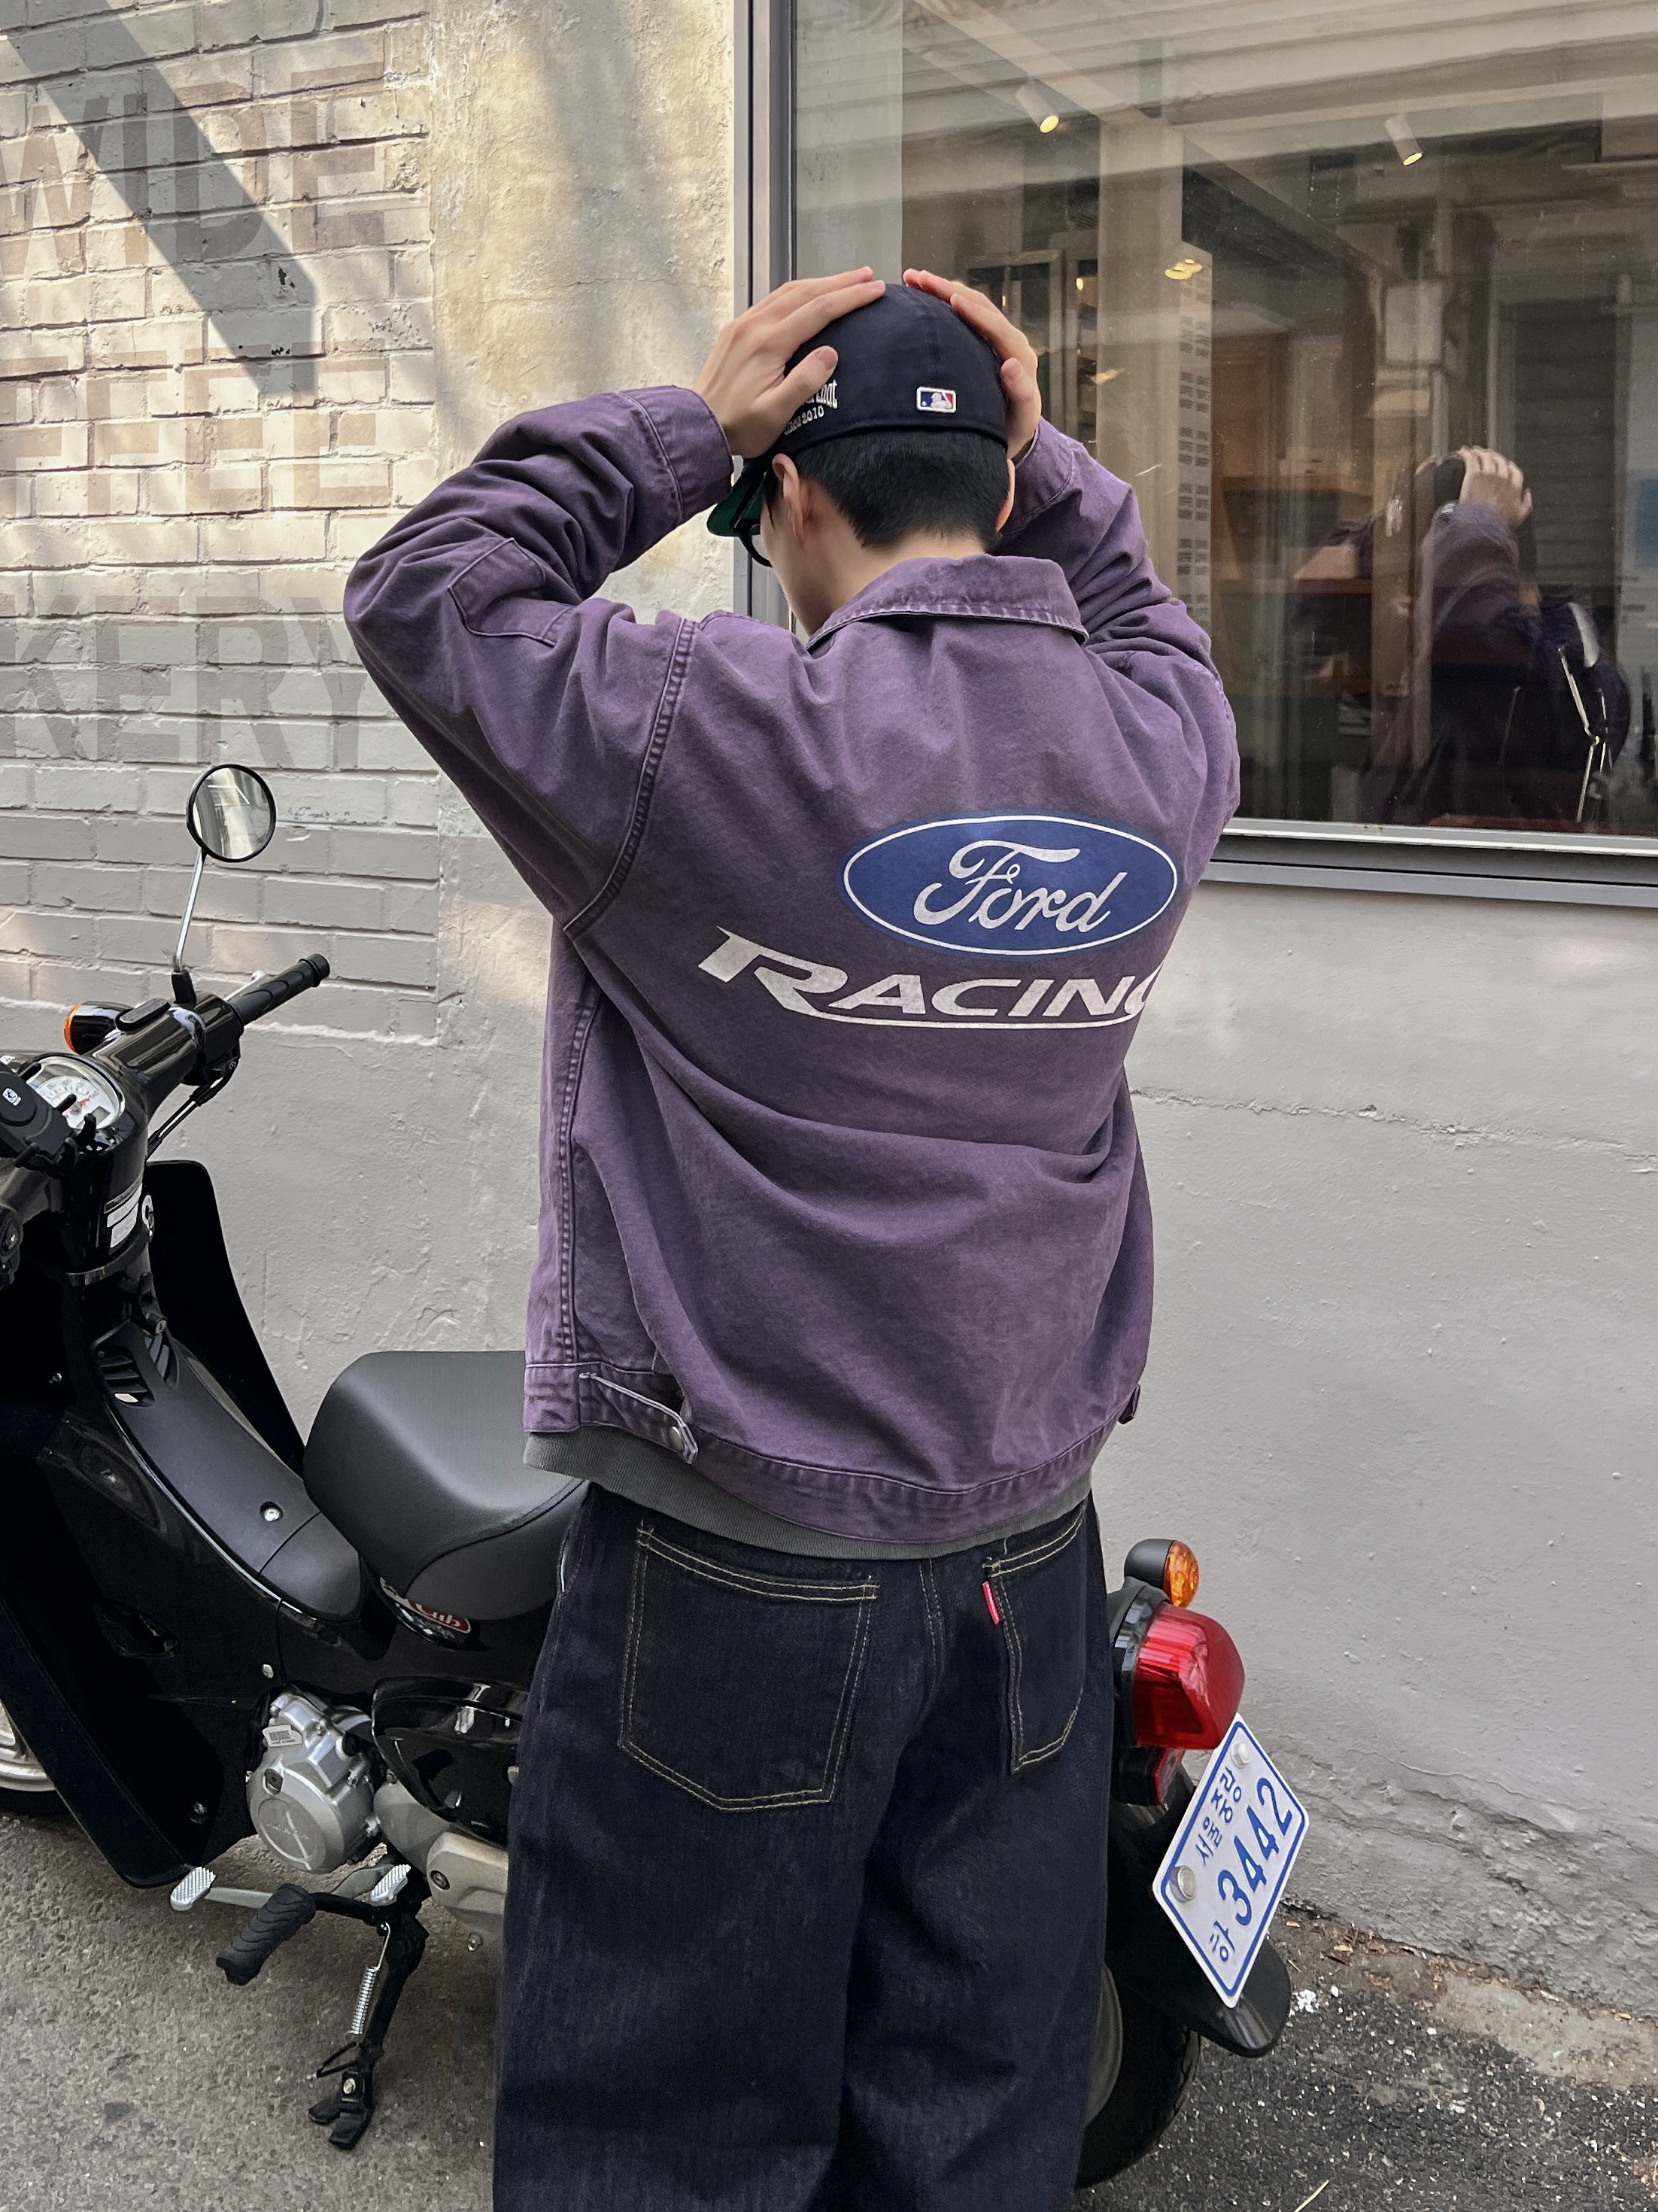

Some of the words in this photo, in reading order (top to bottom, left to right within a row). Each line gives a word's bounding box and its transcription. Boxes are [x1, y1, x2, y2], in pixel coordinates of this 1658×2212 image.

[801, 405, 824, 424] 2010
[913, 840, 1128, 933] Ford
[1195, 1815, 1222, 1865] 서울
[1211, 1766, 1242, 1824] 중랑
[1217, 1777, 1293, 1927] 3442
[1209, 1920, 1235, 1962] 하
